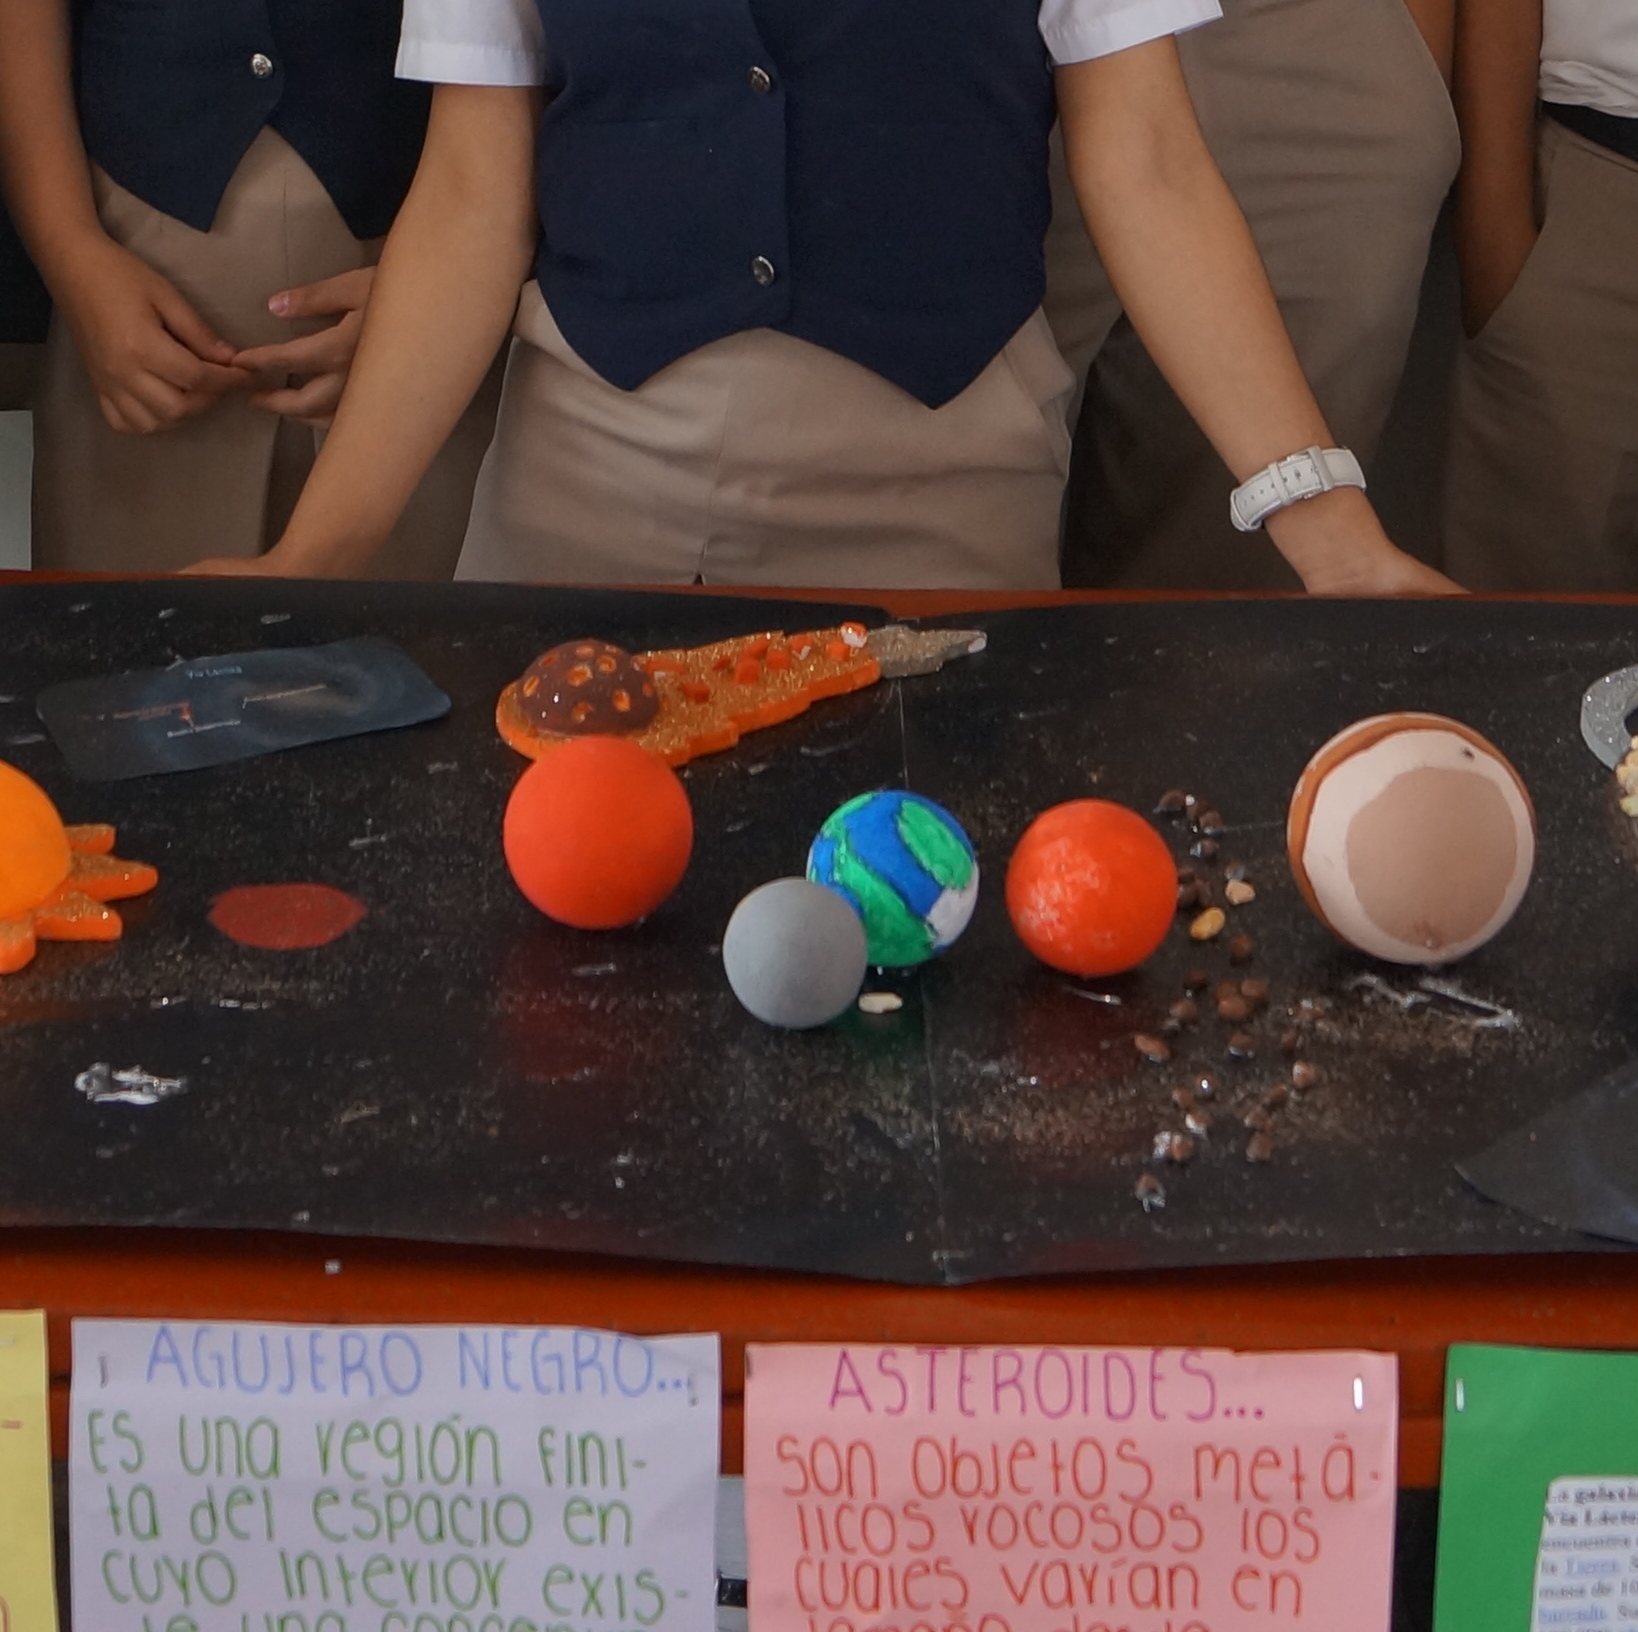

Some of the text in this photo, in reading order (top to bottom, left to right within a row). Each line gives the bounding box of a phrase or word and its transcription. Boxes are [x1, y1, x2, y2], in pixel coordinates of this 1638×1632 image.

[145, 1325, 423, 1397] AGUJERO
[179, 1413, 280, 1478] una
[315, 1413, 503, 1489] región
[106, 1483, 635, 1550] ta del espacio en
[958, 1500, 1206, 1554] rocosos
[1240, 1503, 1321, 1563] los
[102, 1549, 239, 1609] cuyo
[278, 1550, 508, 1614] interior
[794, 1556, 971, 1614] cuales
[1231, 1568, 1304, 1617] en
